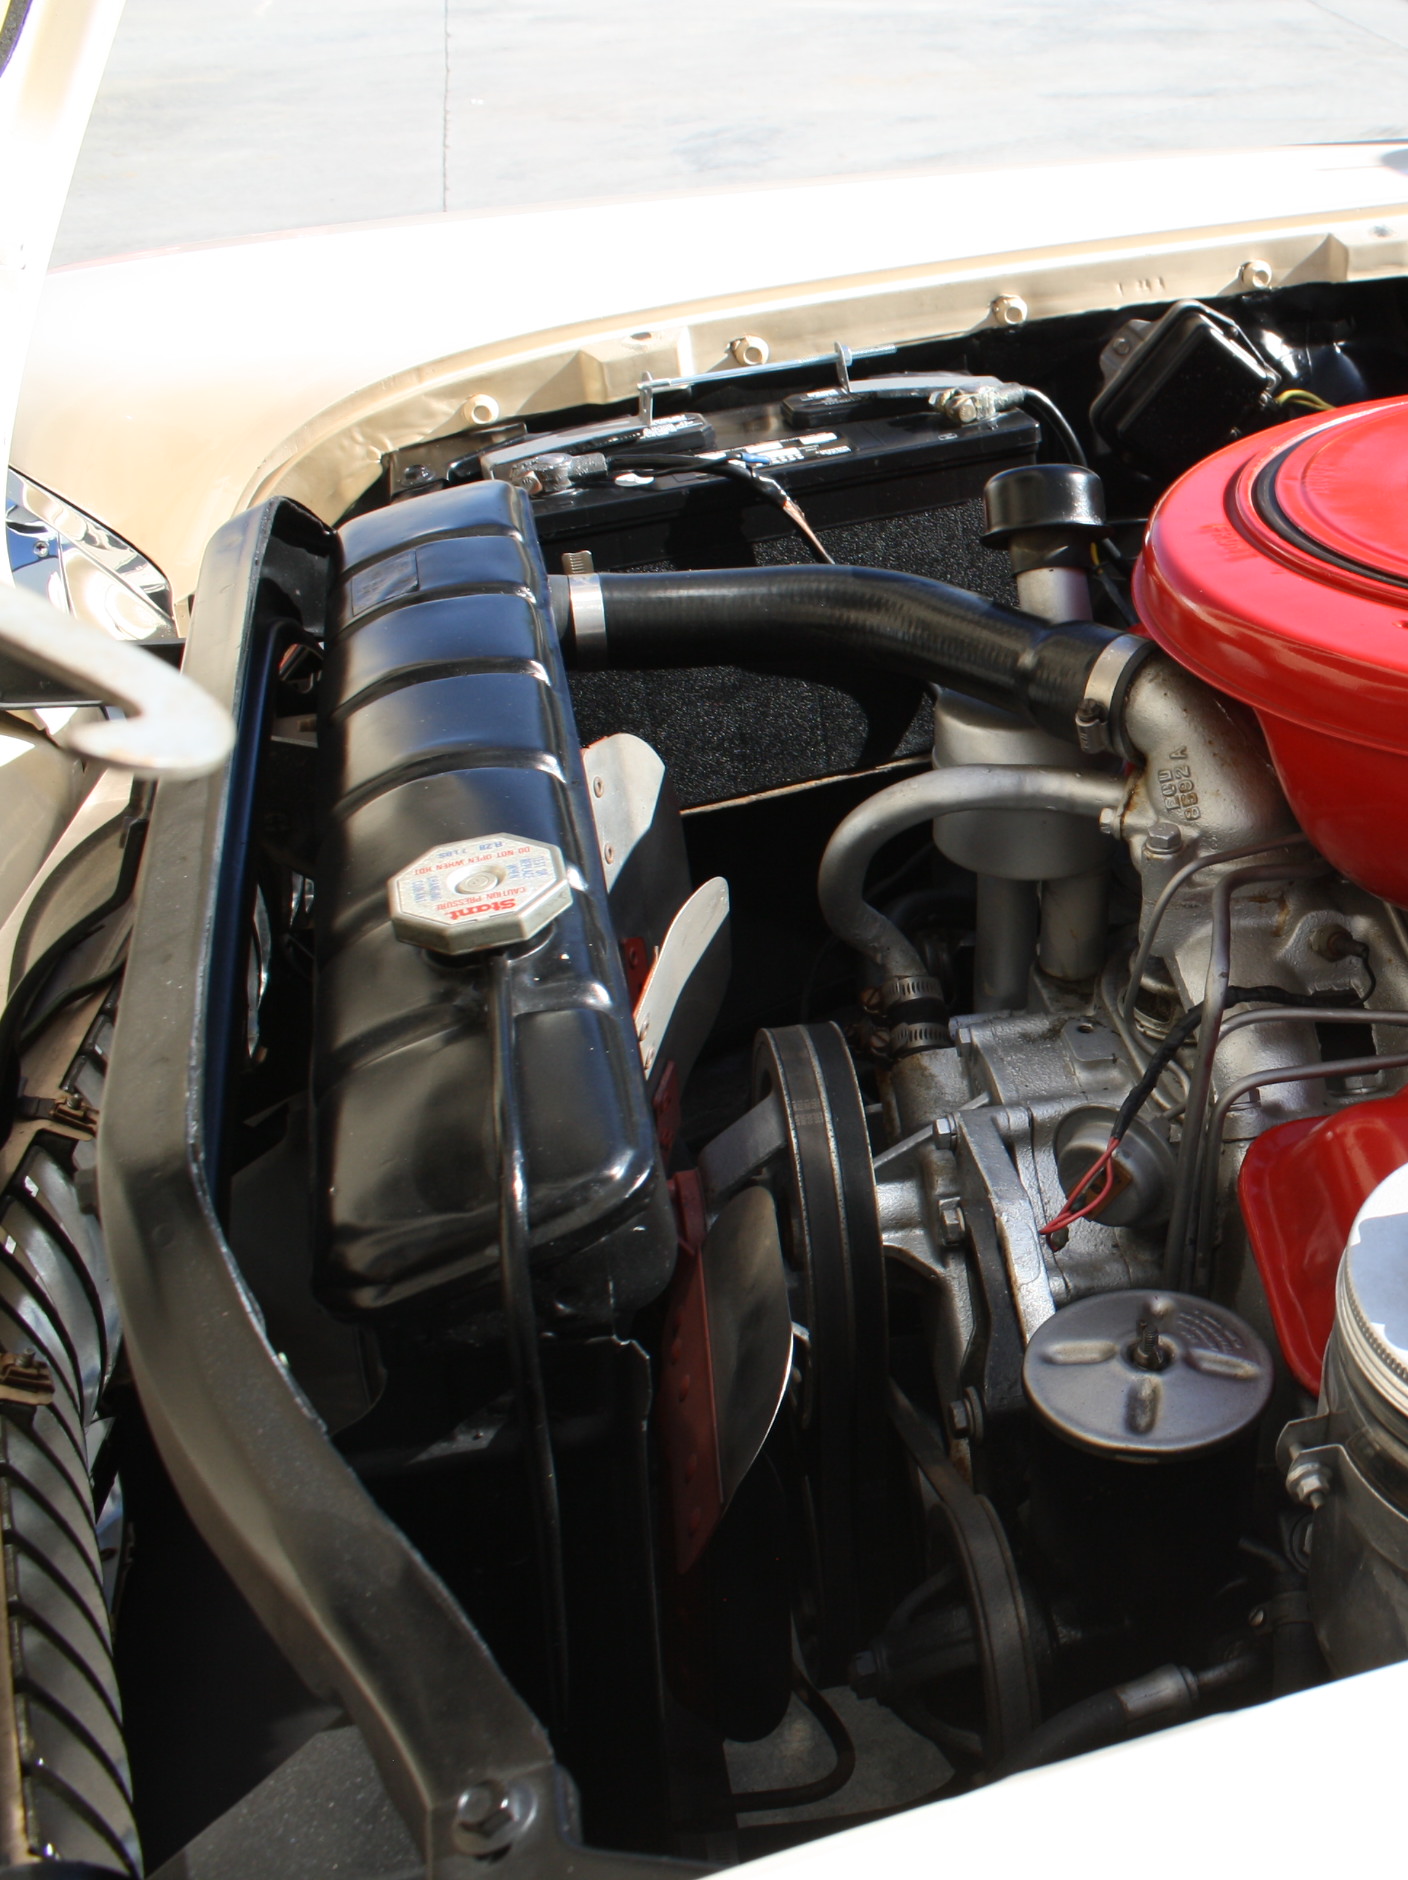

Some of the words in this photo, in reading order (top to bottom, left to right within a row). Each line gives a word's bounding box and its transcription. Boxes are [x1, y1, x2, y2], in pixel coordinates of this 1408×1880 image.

[496, 849, 515, 859] NOT
[518, 846, 531, 854] DO
[468, 853, 493, 863] OPEN
[436, 859, 466, 871] WHEN
[414, 866, 433, 876] HOT
[486, 886, 527, 900] CAUTION
[436, 896, 482, 911] PRESSURE
[449, 899, 516, 920] Stant
